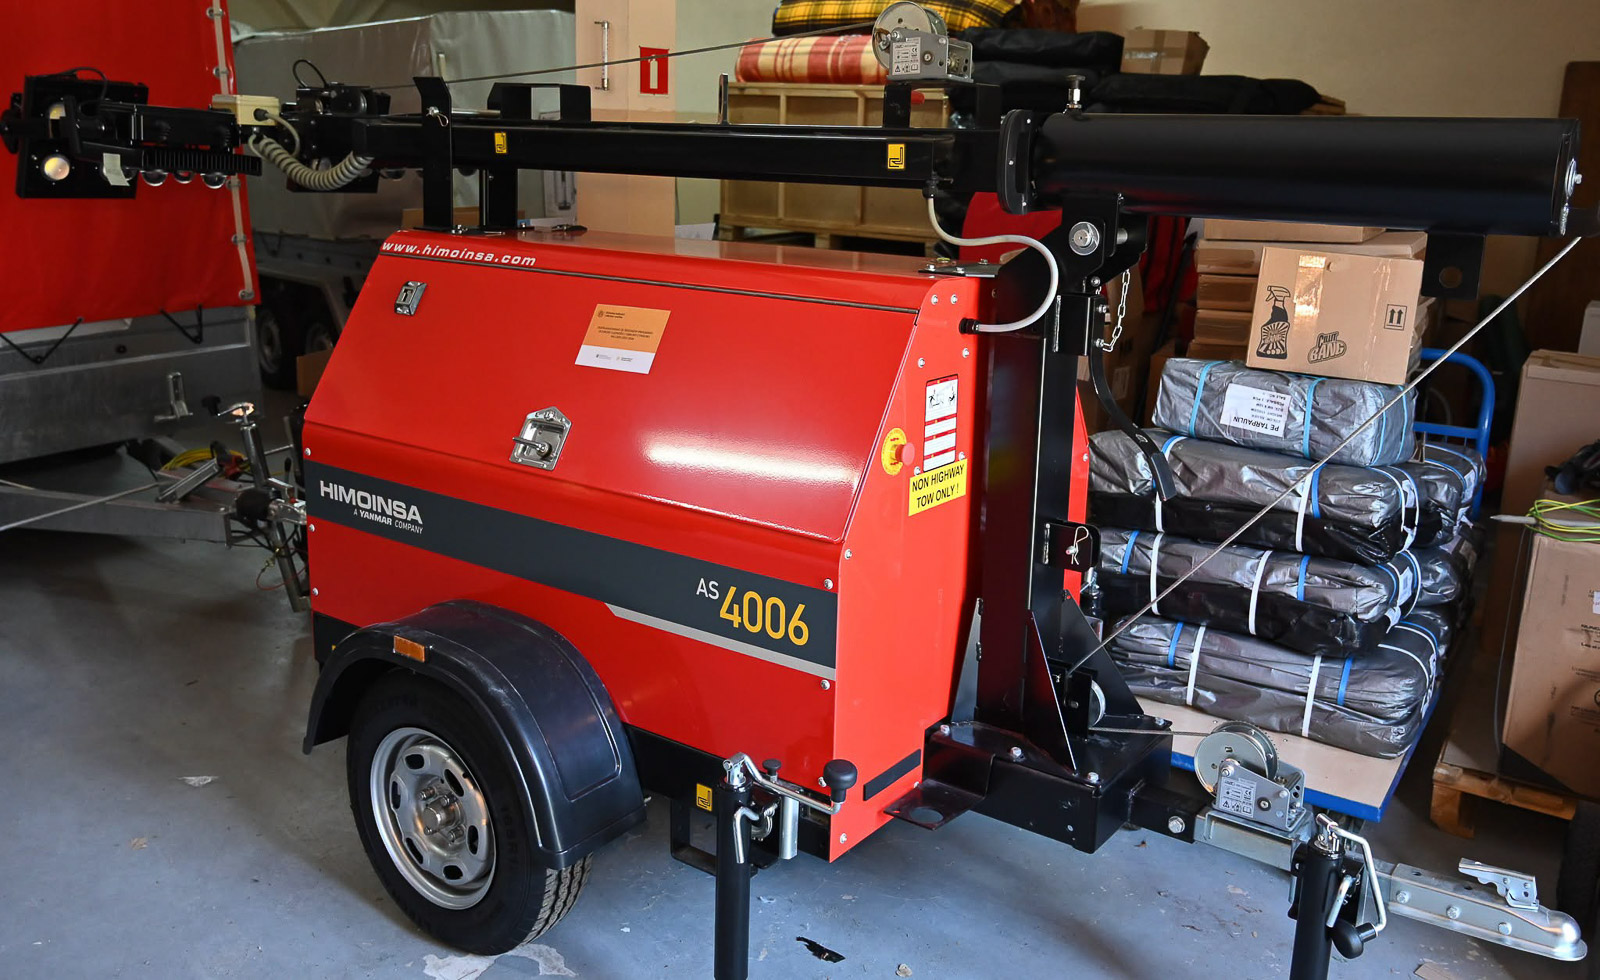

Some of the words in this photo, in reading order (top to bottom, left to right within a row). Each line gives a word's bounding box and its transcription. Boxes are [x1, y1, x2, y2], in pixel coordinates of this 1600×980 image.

[382, 241, 537, 266] www.himoinsa.com
[1310, 341, 1345, 361] BANG
[1233, 416, 1268, 428] TARPAULIN
[912, 478, 929, 492] NON
[930, 464, 964, 485] HIGHWAY
[319, 480, 423, 525] HIMOINSA
[917, 493, 935, 508] TOW
[935, 486, 955, 502] ONLY
[353, 508, 358, 516] A
[359, 509, 392, 526] YANMAR
[394, 519, 424, 535] COMPANY
[696, 577, 720, 600] AS
[720, 585, 809, 646] 4006
